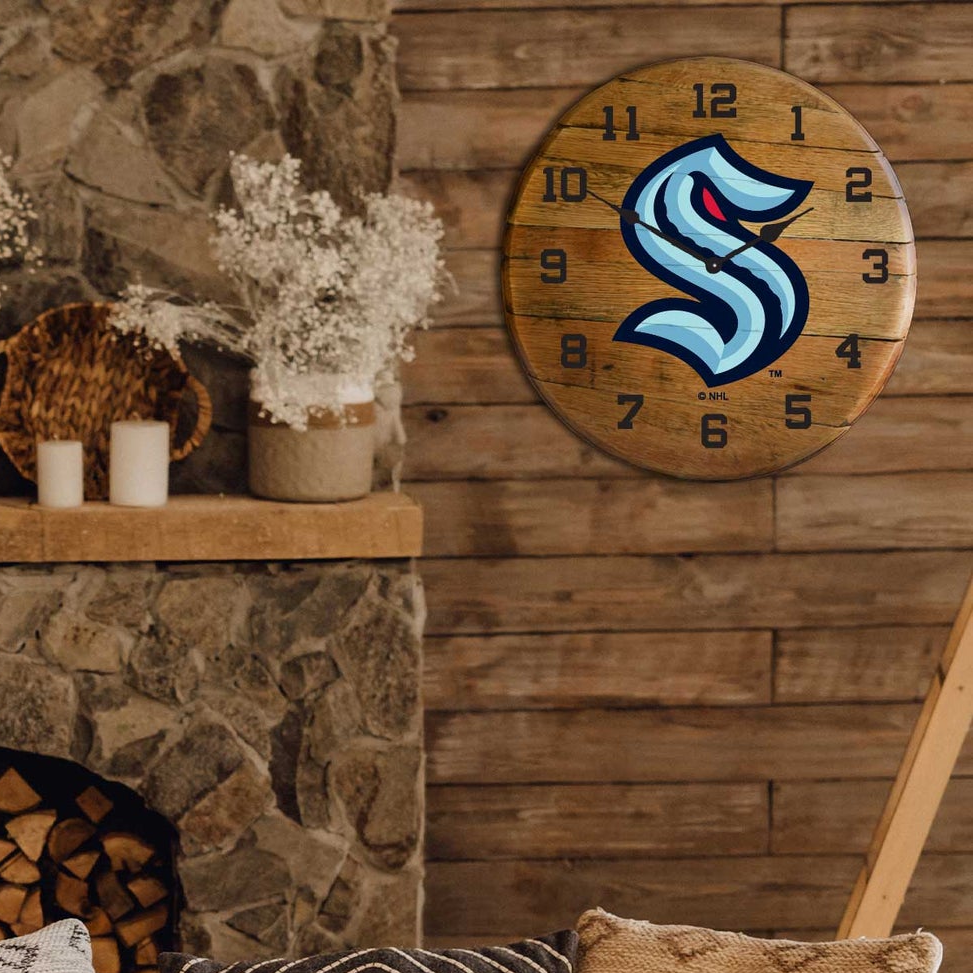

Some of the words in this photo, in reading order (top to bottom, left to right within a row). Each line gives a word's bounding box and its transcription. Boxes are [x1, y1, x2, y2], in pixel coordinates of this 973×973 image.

[692, 83, 737, 118] 12
[602, 106, 640, 140] 11
[790, 106, 805, 140] 1
[543, 167, 588, 202] 10
[845, 167, 873, 202] 2
[540, 249, 567, 284] 9
[862, 249, 889, 284] 3
[560, 334, 588, 369] 8
[835, 334, 862, 368] 4
[617, 394, 644, 430] 7
[708, 391, 729, 401] NHL
[785, 394, 812, 430] 5
[701, 413, 728, 449] 6
